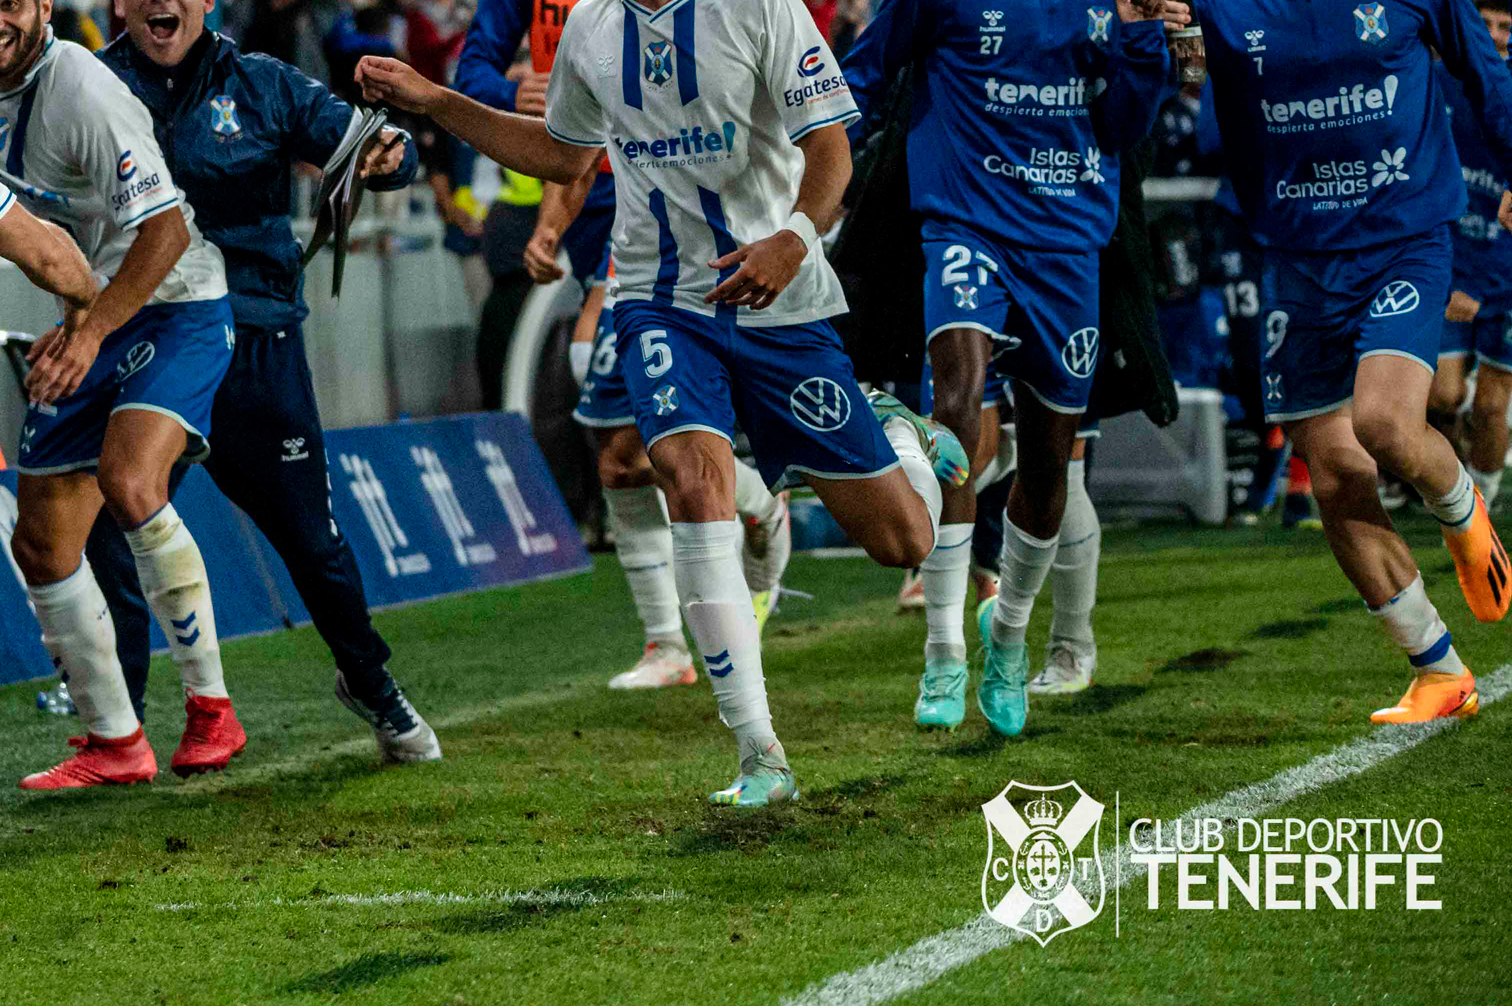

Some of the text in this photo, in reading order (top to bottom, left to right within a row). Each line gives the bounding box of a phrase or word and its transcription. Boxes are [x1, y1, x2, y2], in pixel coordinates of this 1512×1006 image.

[979, 35, 1004, 55] 27
[1252, 56, 1263, 76] 7
[783, 75, 849, 108] Egatesa
[984, 102, 1044, 117] despierta
[1266, 110, 1386, 135] despierta emociones
[1029, 147, 1081, 166] Islas
[982, 154, 1078, 184] Canarias
[1312, 159, 1368, 180] Islas
[1275, 176, 1369, 200] Canarias
[1224, 280, 1260, 318] 13
[639, 329, 674, 379] 5
[281, 450, 309, 462] hummel
